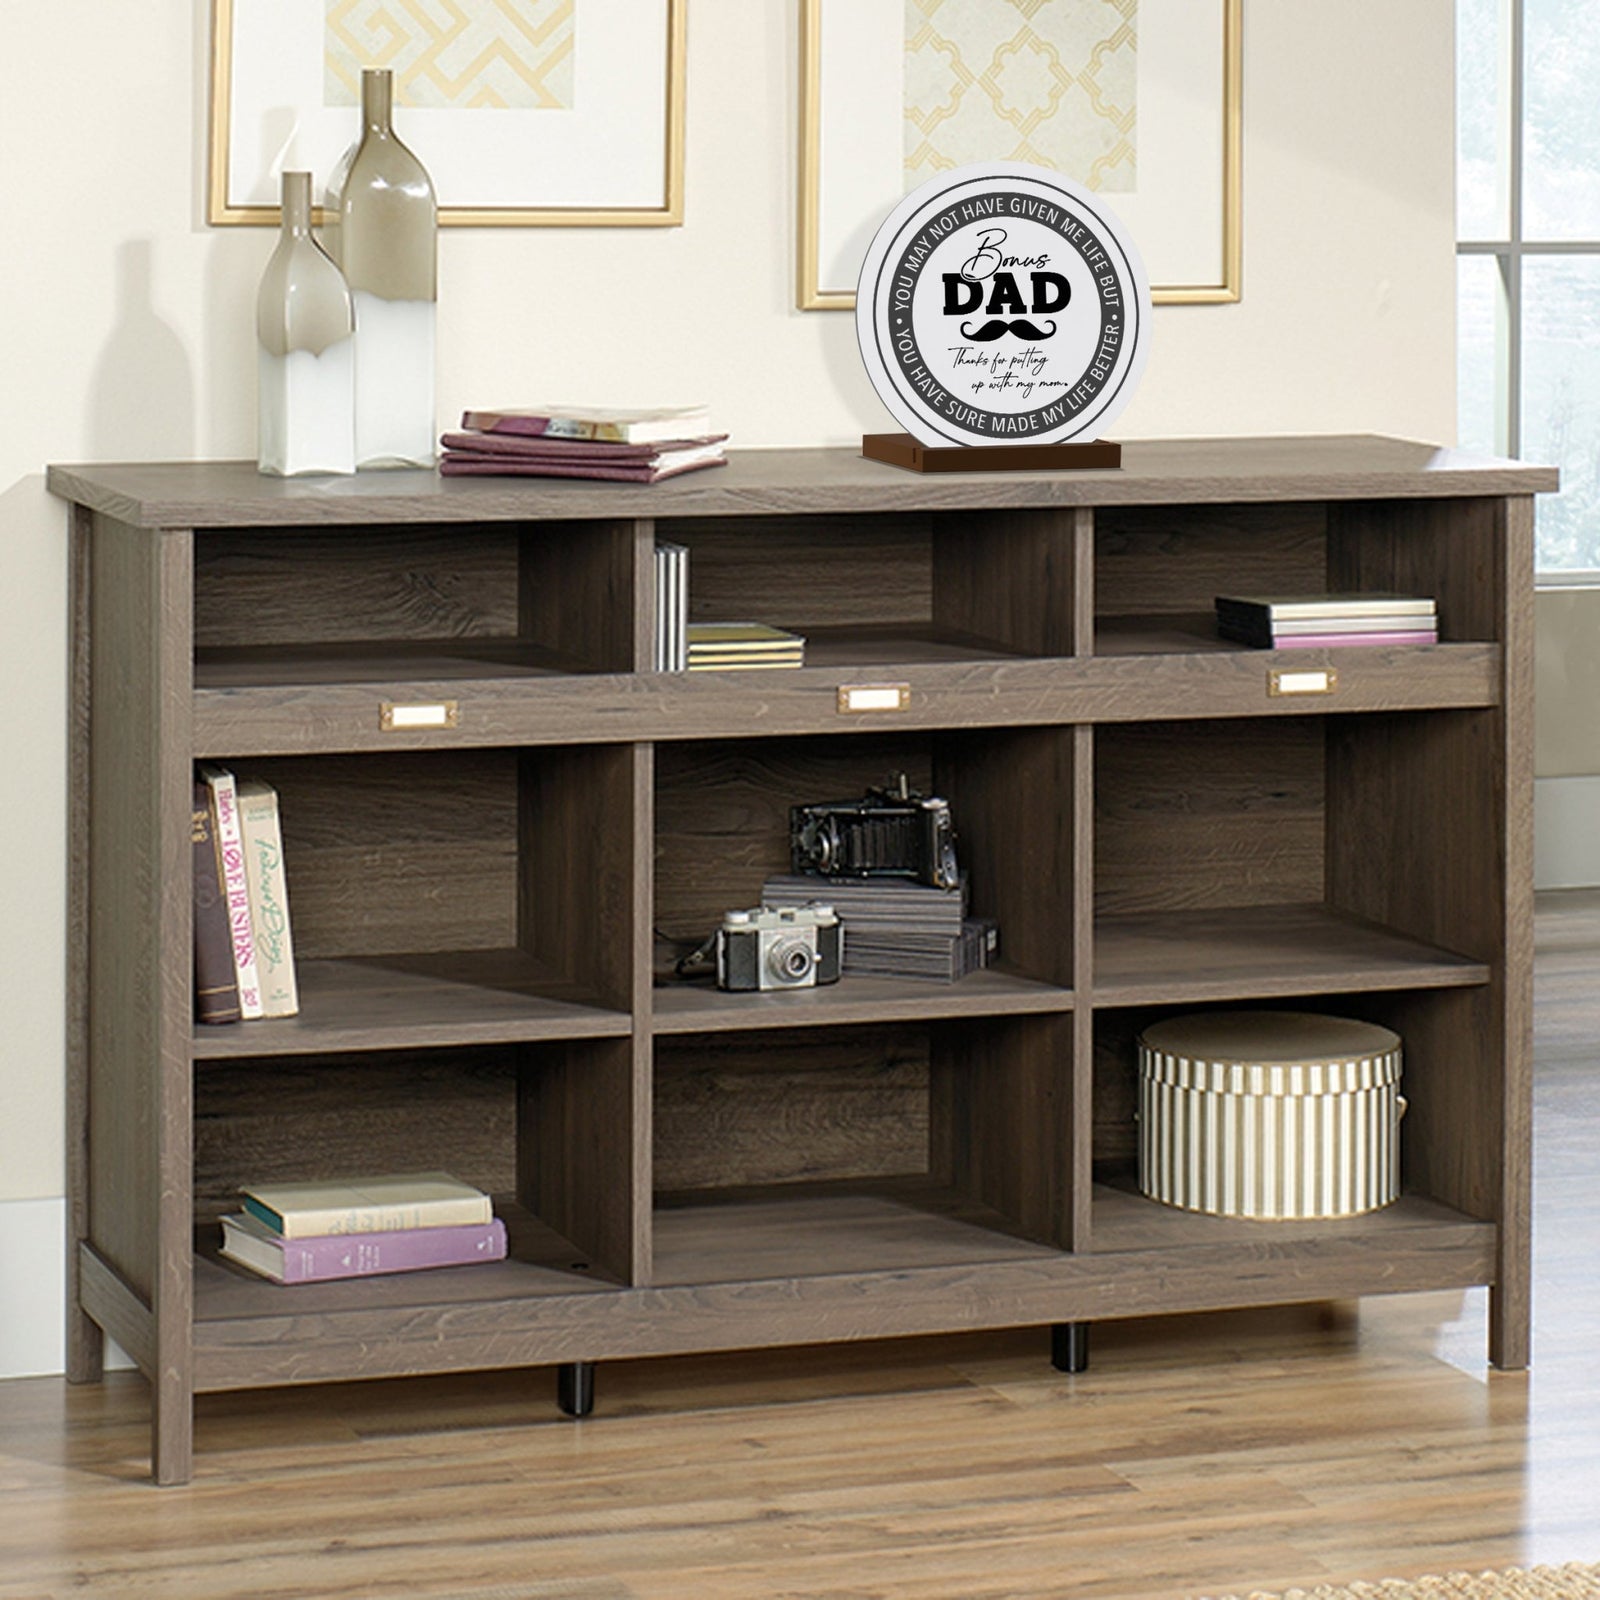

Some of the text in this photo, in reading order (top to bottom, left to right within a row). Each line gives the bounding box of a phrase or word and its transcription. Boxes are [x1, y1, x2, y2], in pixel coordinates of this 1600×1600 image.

[895, 197, 1120, 311] YOU MAY NOT HAVE GIVEN ME LIFE BUT
[961, 228, 1051, 282] Bonus
[941, 271, 1072, 316] DAD
[896, 324, 1120, 433] YOU HAVE SURE MADE MY LIFE BETTER
[947, 346, 1049, 376] Thanks for putting
[971, 381, 984, 394] up
[988, 371, 1020, 393] with
[1016, 381, 1036, 399] my
